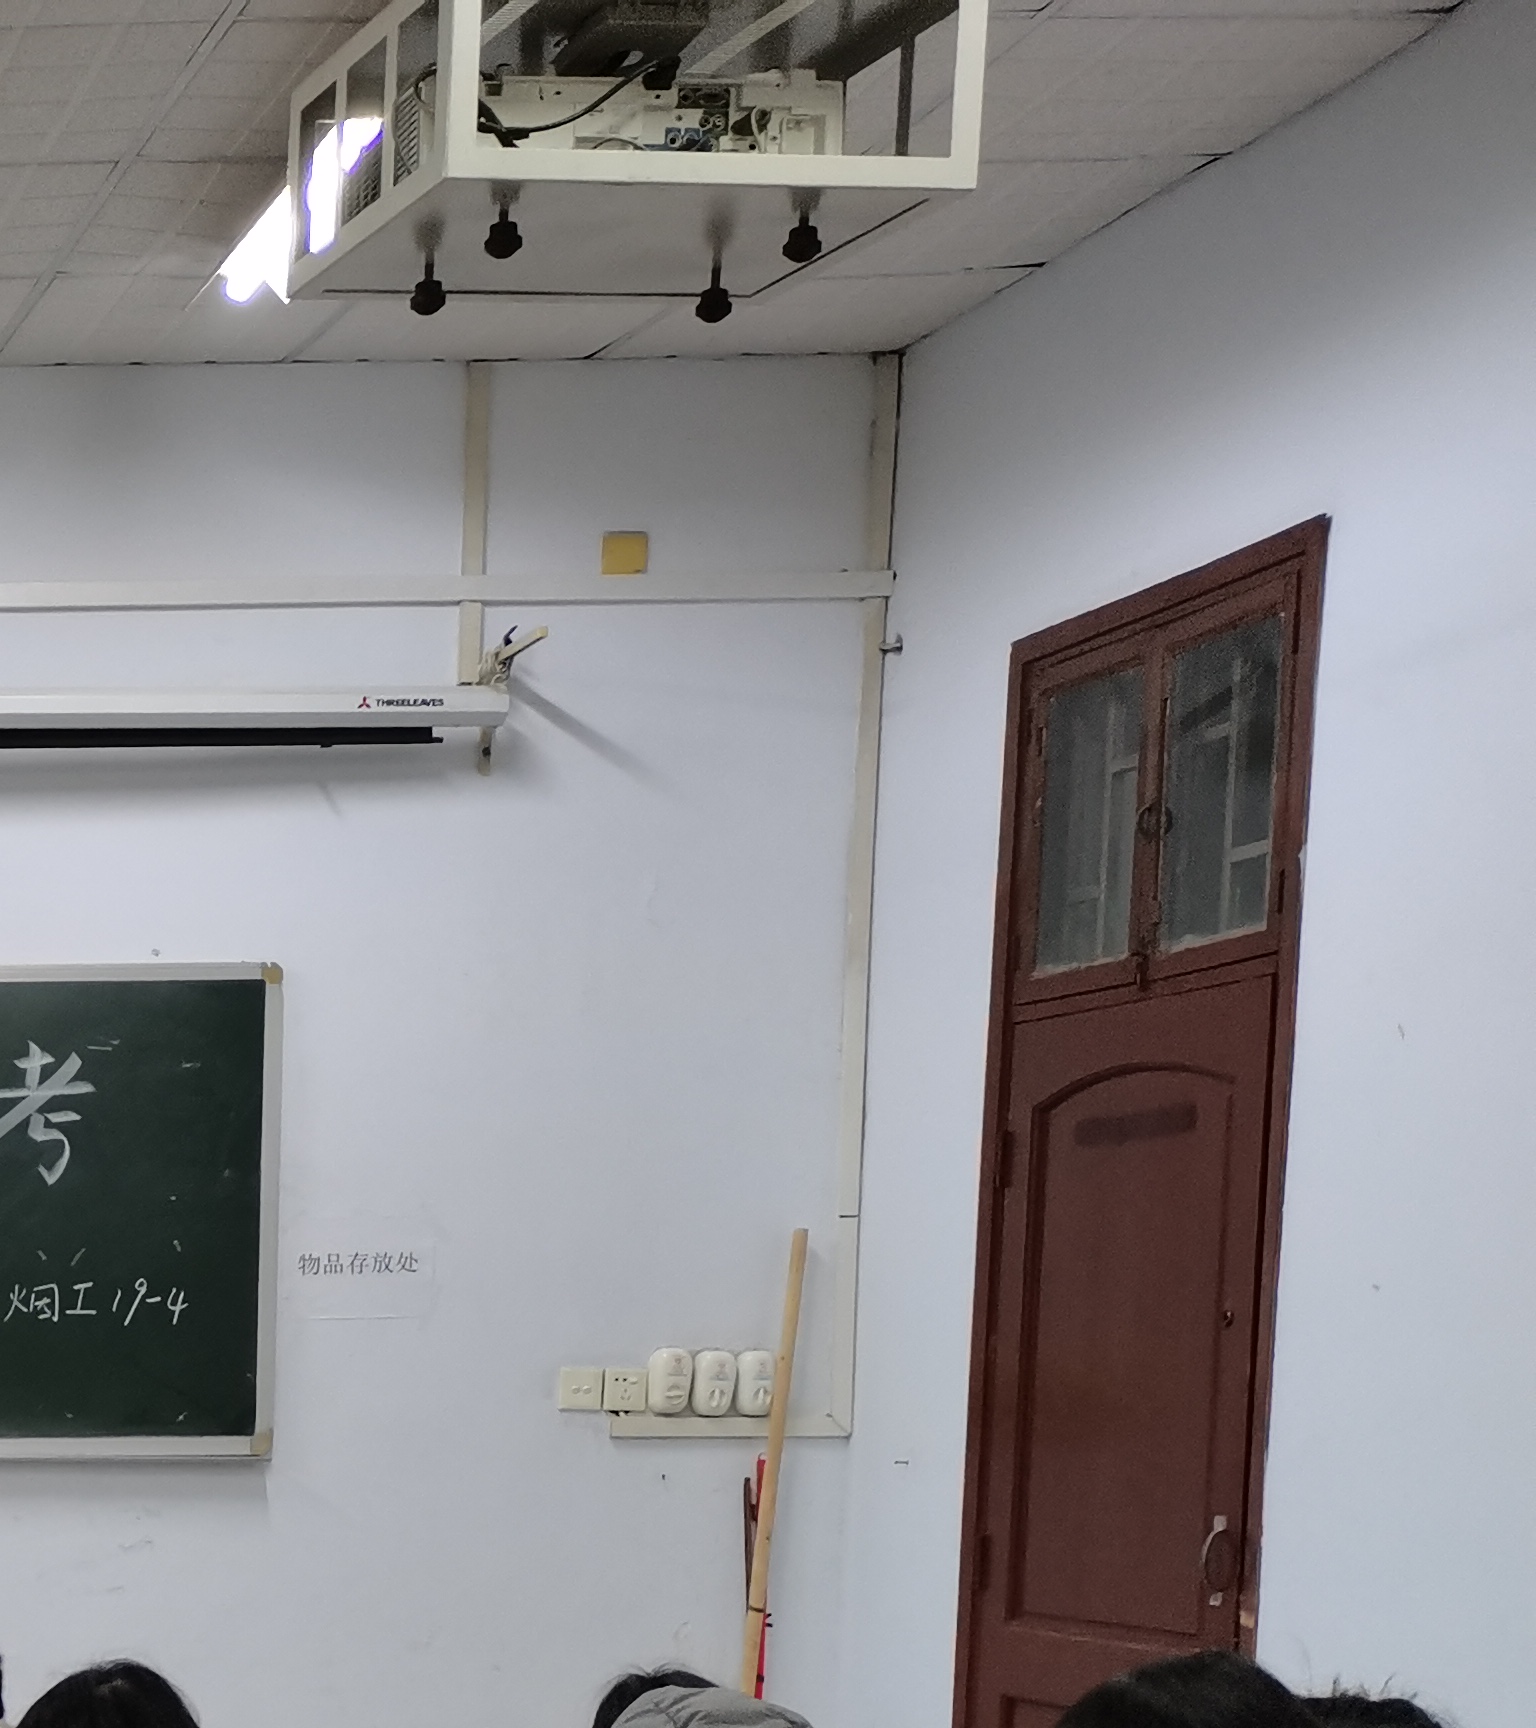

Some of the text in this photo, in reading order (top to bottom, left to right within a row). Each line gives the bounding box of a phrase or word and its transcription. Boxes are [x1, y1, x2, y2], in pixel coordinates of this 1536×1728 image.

[375, 698, 444, 707] THREELEAVES
[297, 1251, 419, 1276] 物品存放处
